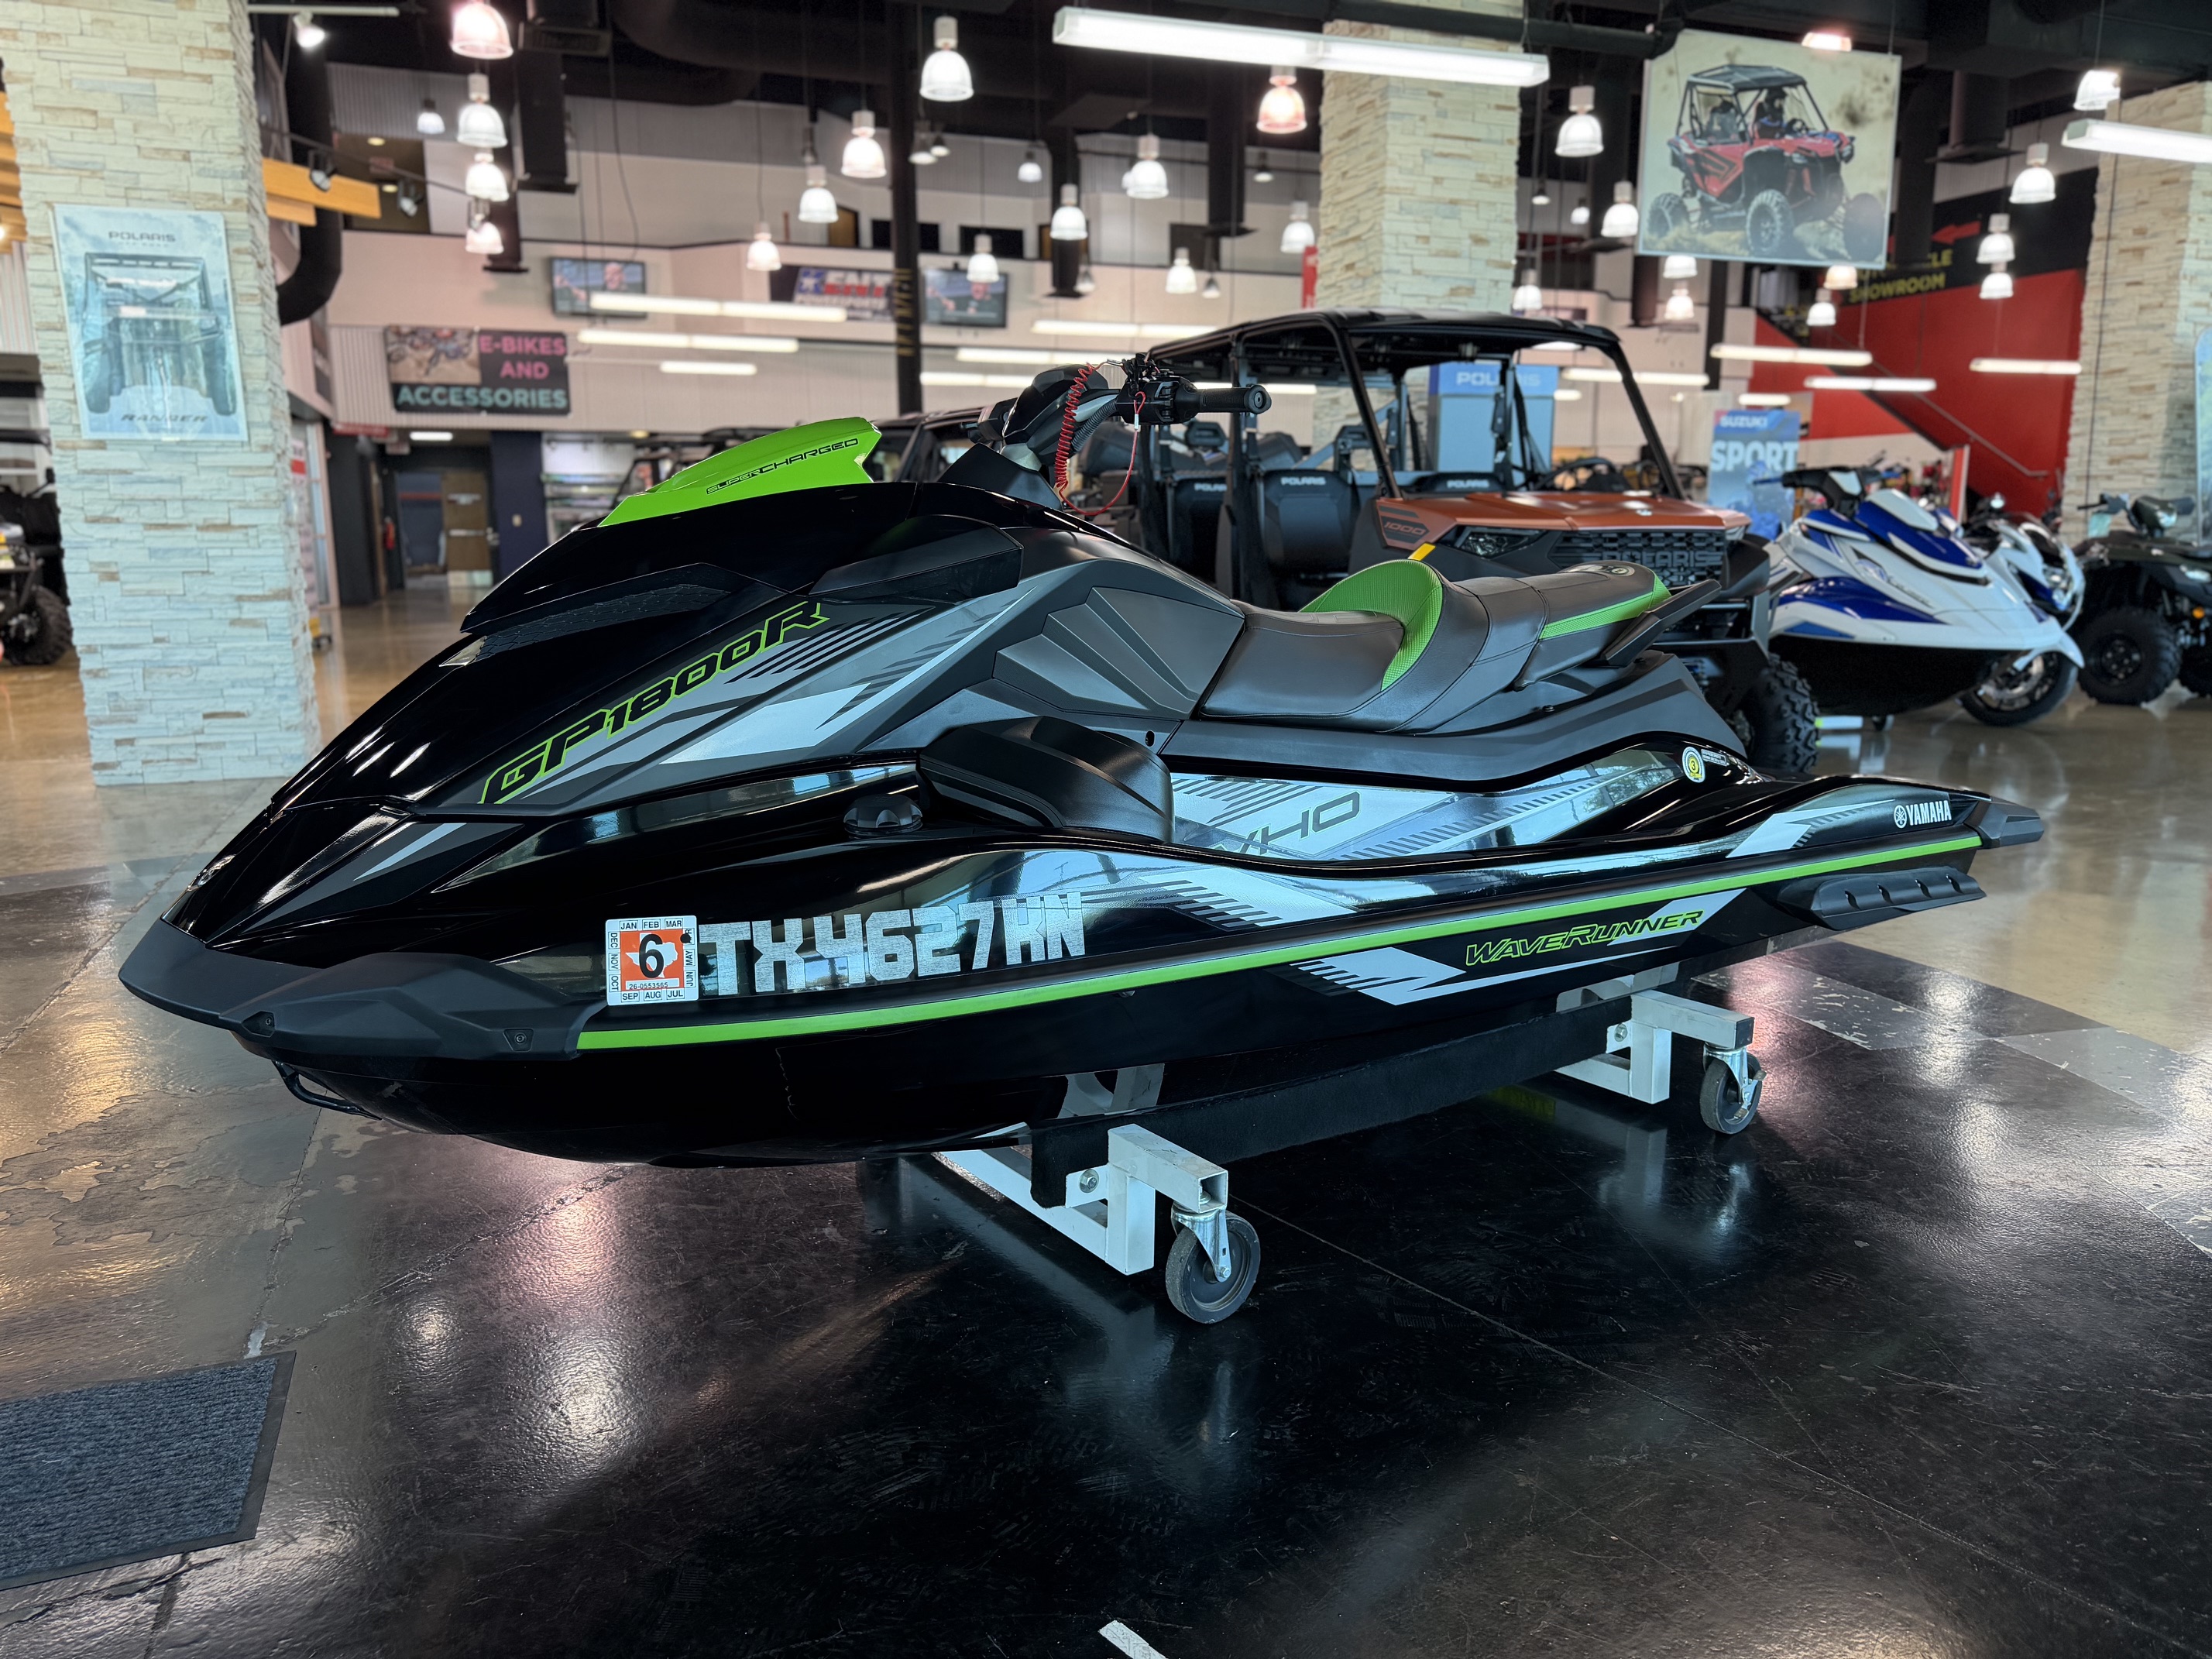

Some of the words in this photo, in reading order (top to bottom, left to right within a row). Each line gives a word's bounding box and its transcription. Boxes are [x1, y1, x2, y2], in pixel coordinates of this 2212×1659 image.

[108, 232, 176, 242] POLARIS
[479, 335, 567, 356] E-BIKES
[500, 361, 550, 380] AND
[1457, 372, 1541, 386] POLIS
[397, 386, 568, 409] ACCESSORIES
[1720, 415, 1767, 428] SUZUKI
[706, 438, 858, 494] SUPERCHARGED
[1710, 440, 1799, 472] SPORT
[1281, 476, 1326, 486] POLARIS
[1385, 521, 1427, 535] 1000
[478, 601, 830, 805] GP1800R
[1905, 800, 1952, 826] YAMAHA
[639, 933, 664, 978] 6
